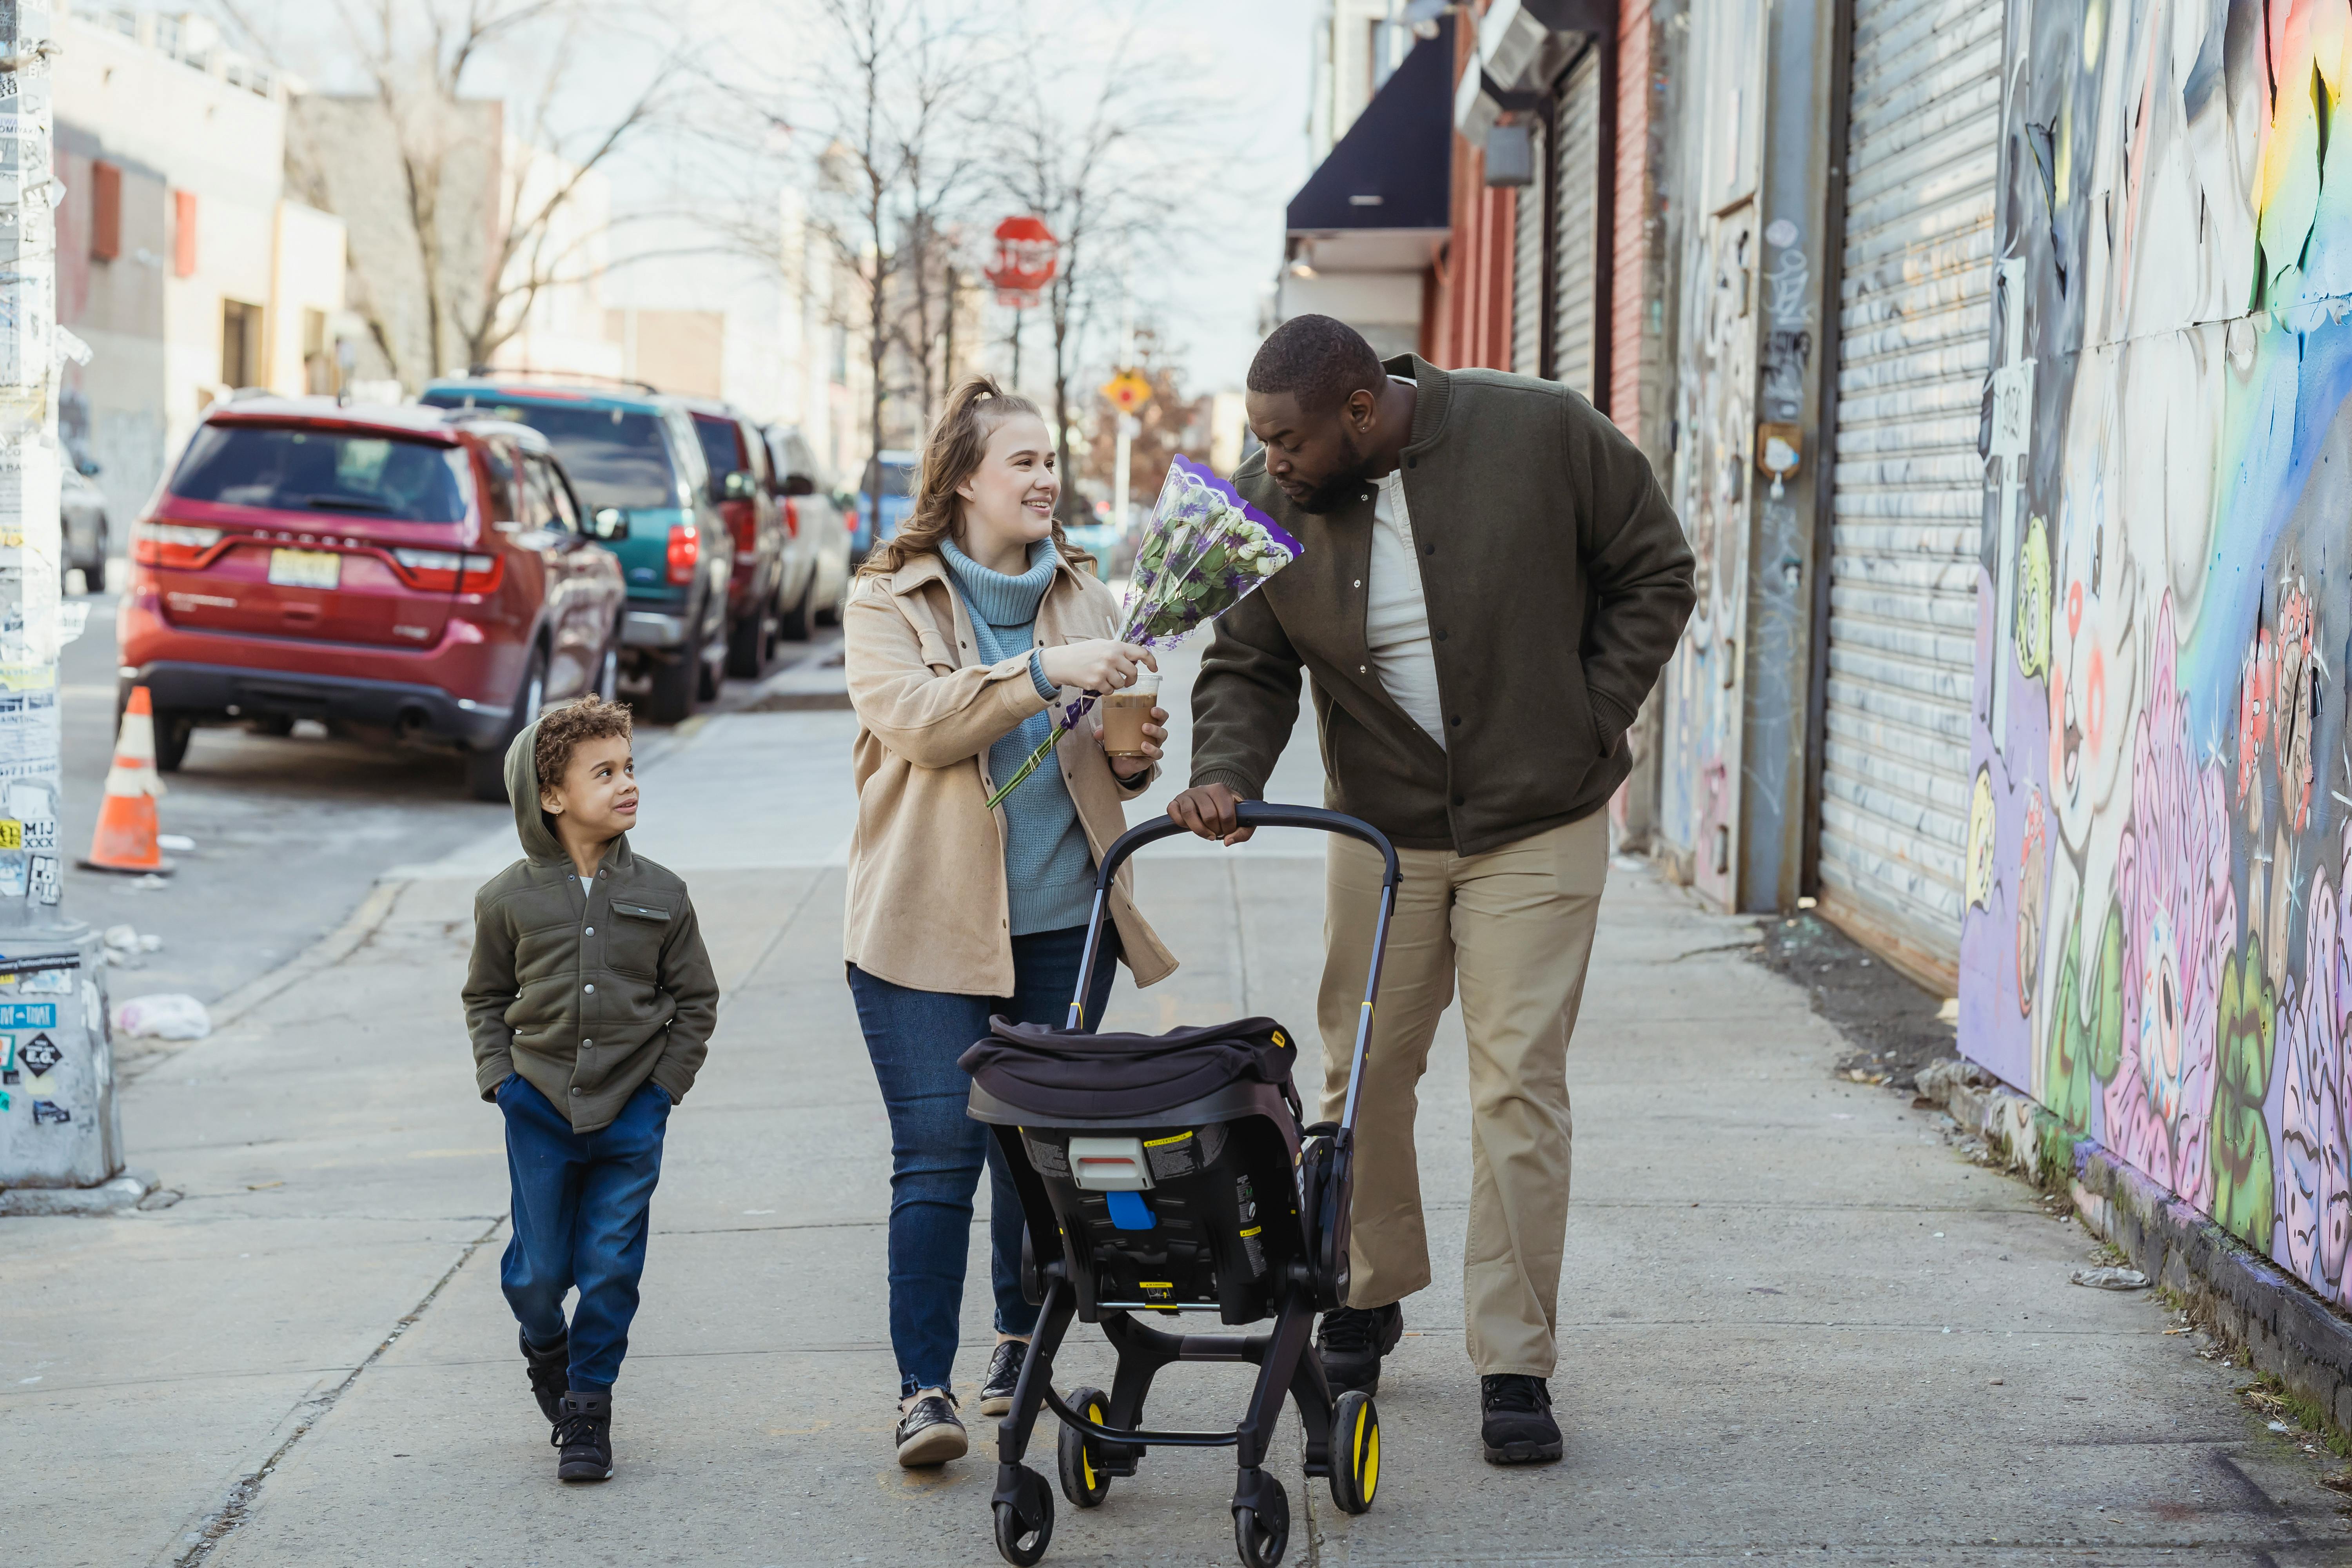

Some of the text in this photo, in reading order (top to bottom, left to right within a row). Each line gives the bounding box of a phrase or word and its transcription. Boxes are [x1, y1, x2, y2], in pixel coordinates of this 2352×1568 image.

[25, 822, 53, 835] MIJ
[25, 838, 53, 848] XXX
[1151, 1134, 1187, 1145] ADVERTENCIA
